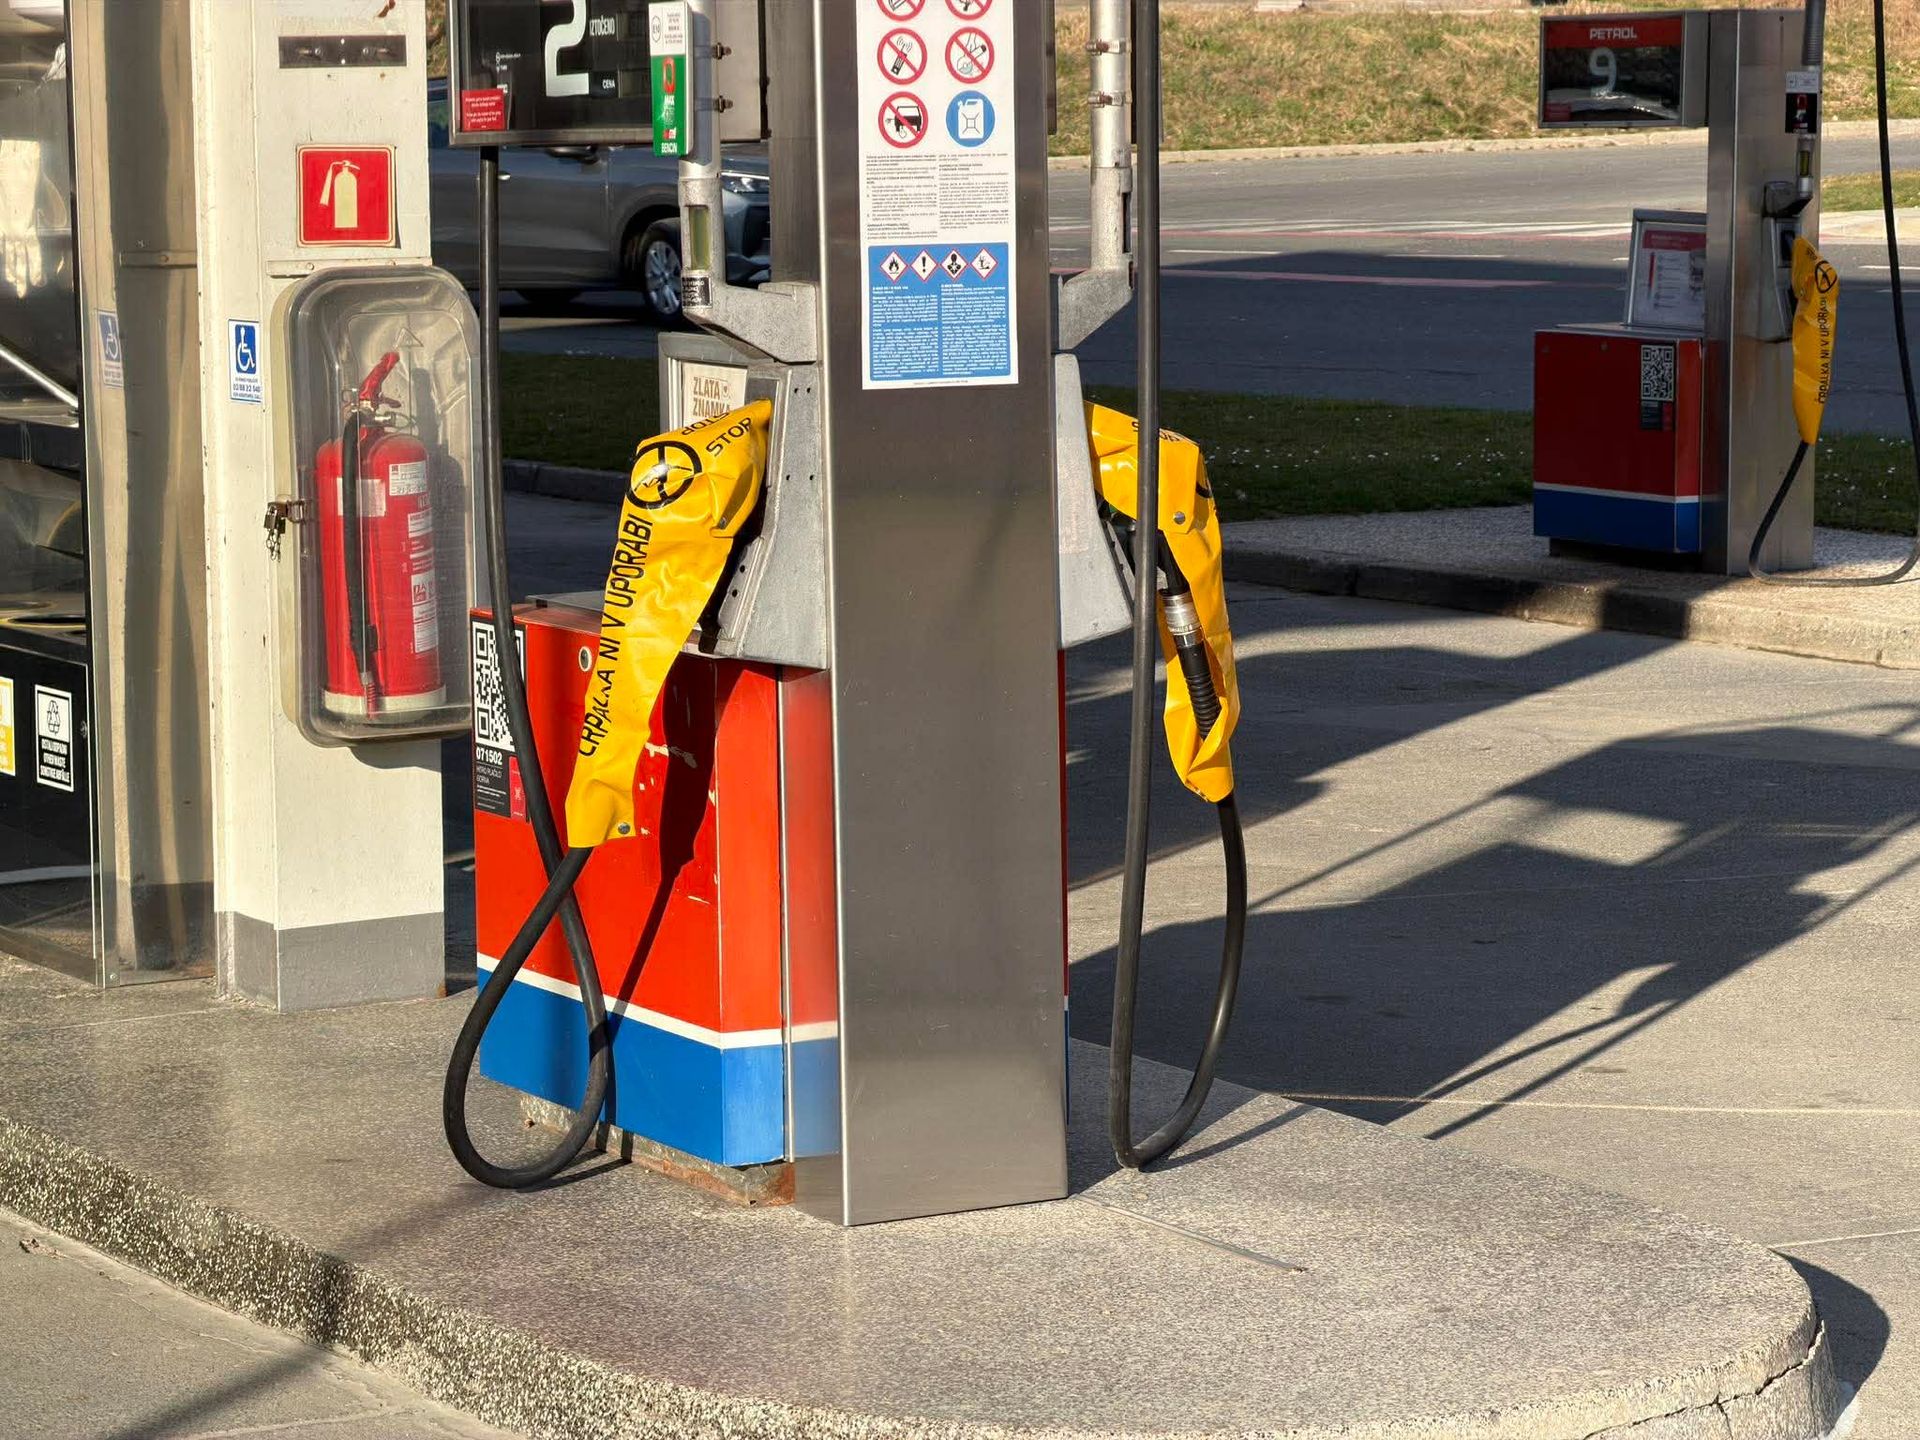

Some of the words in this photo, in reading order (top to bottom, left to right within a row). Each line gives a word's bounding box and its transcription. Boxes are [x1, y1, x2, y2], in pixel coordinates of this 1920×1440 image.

[1590, 27, 1638, 40] PETROL
[545, 0, 589, 97] 2
[602, 79, 615, 89] CENA
[1590, 47, 1617, 98] 9
[693, 376, 721, 401] ZLATA
[706, 417, 752, 457] STOP
[605, 513, 653, 609] UPORABI
[601, 613, 626, 629] V
[599, 637, 621, 661] NI
[476, 746, 503, 766] 071502
